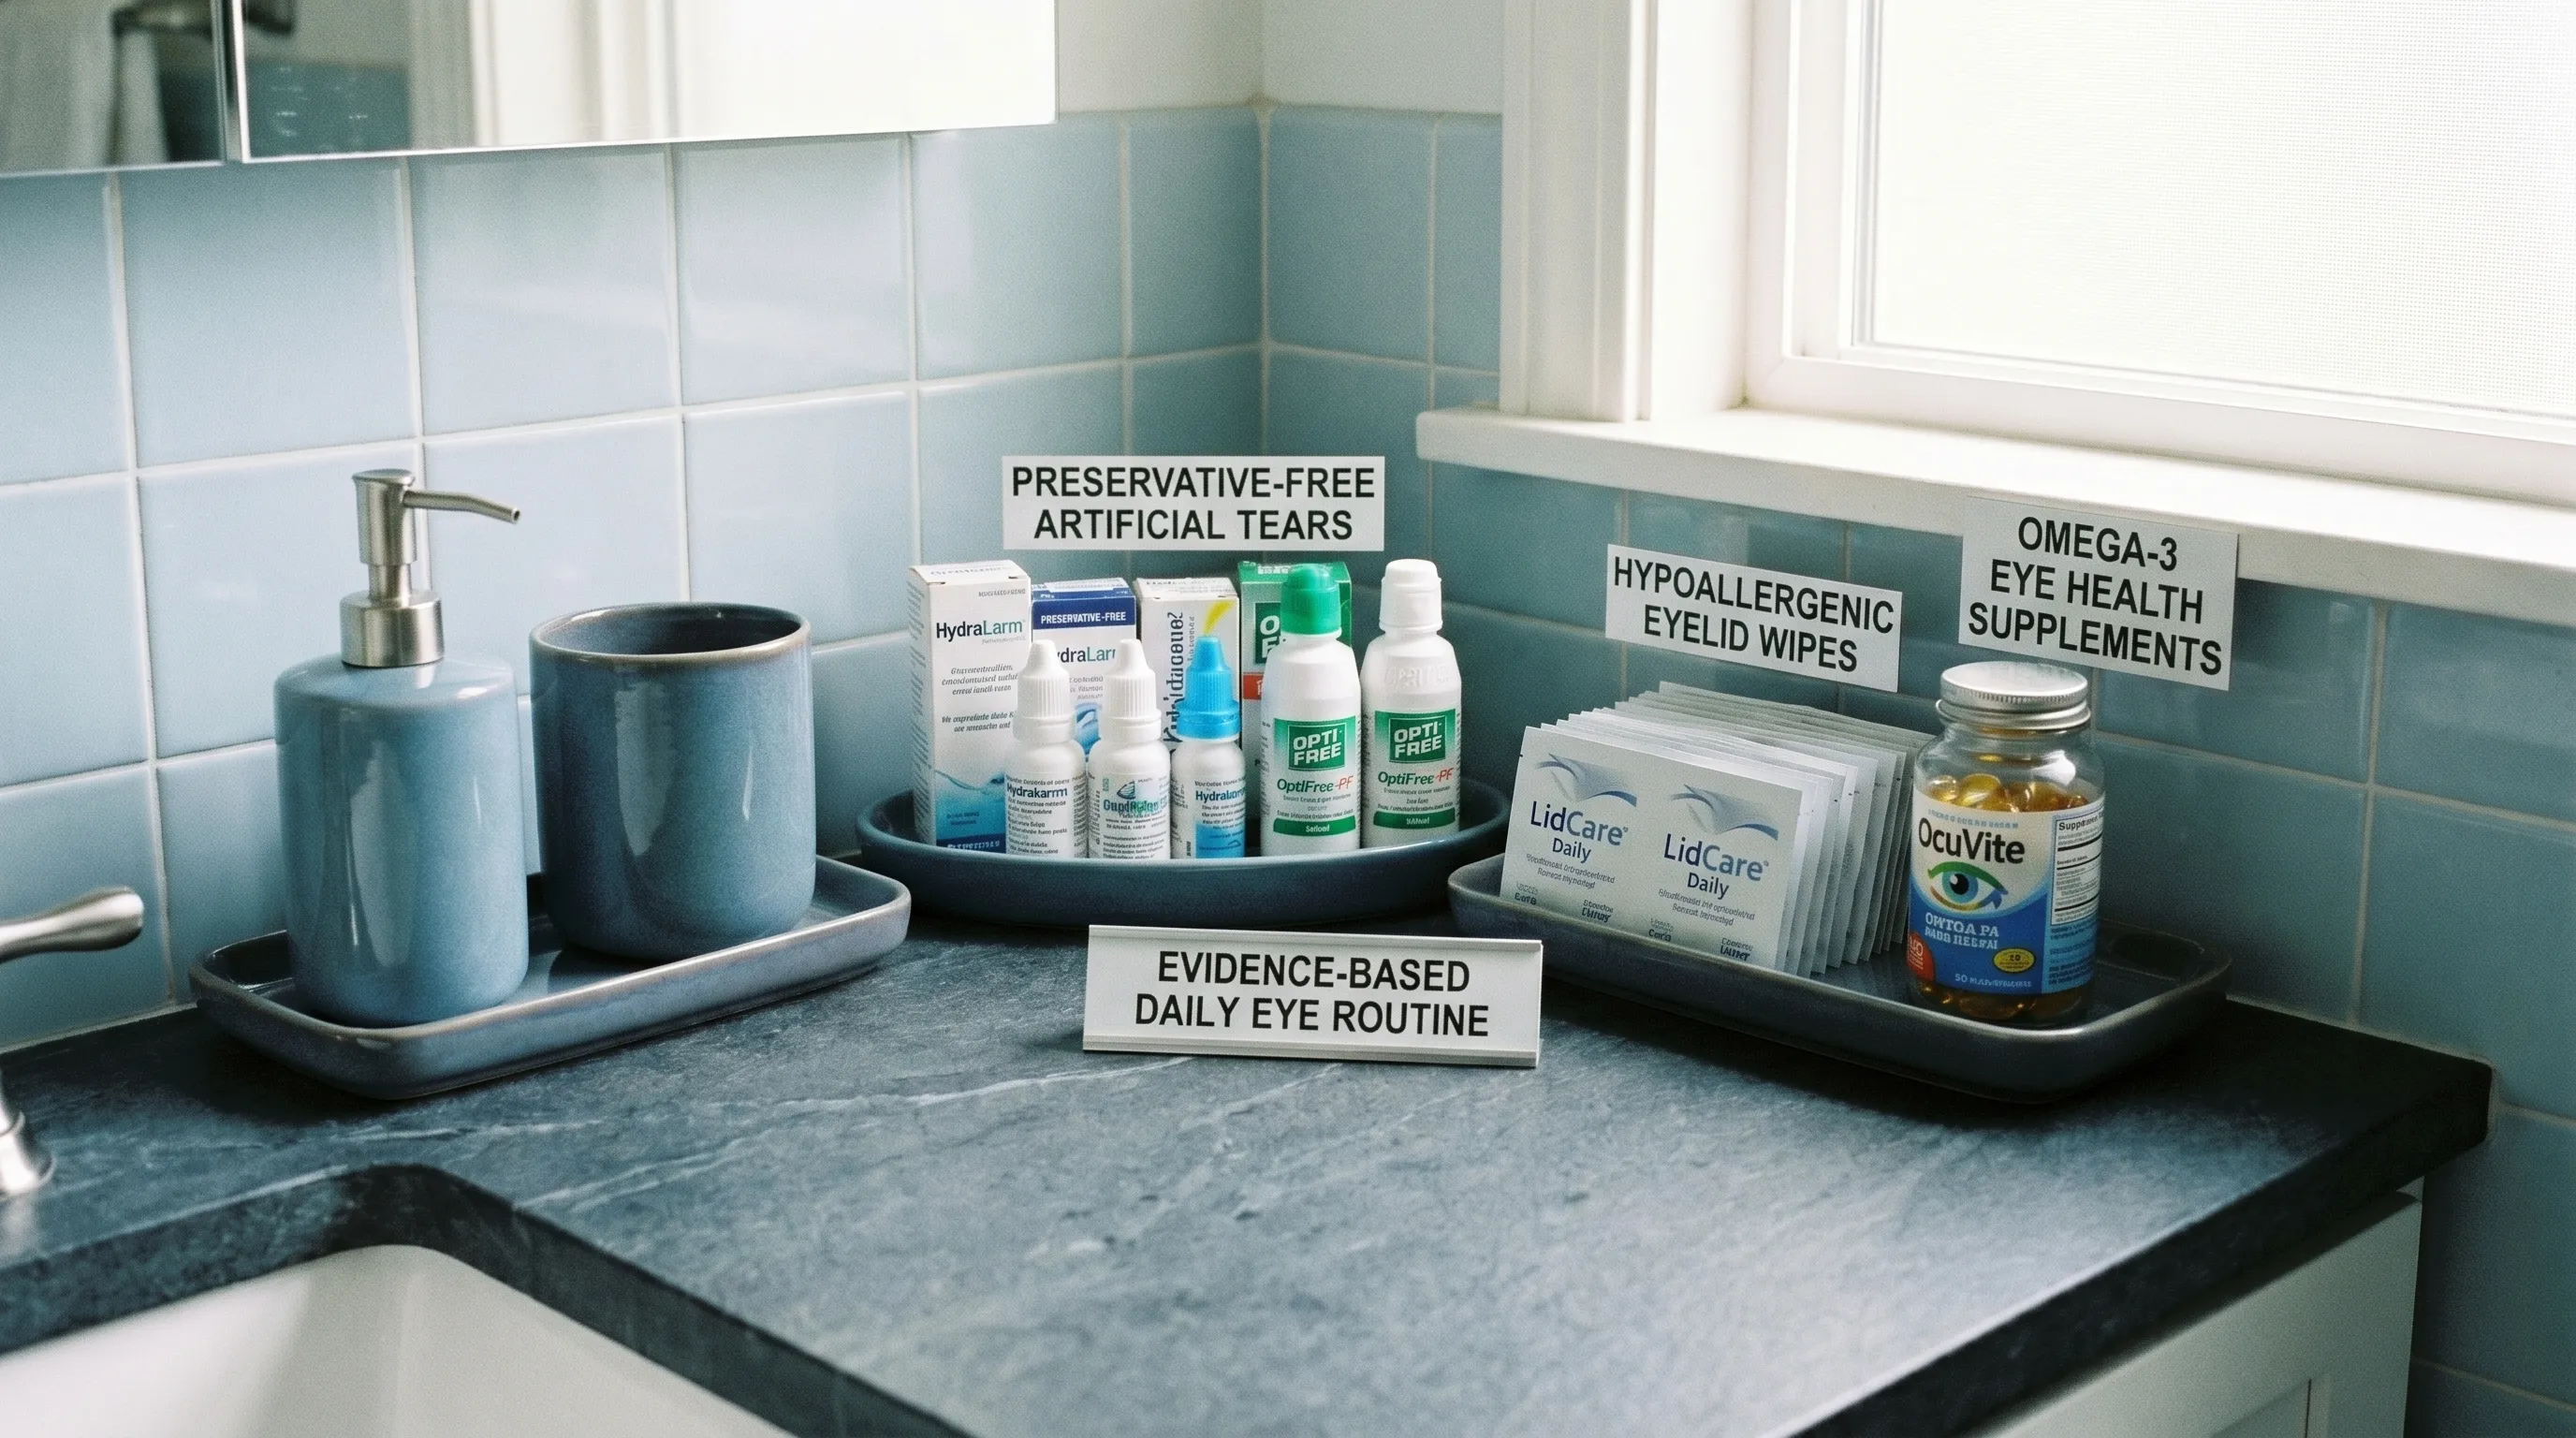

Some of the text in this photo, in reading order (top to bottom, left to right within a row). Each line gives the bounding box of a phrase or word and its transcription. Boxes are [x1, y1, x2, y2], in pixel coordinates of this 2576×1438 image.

[1012, 466, 1375, 498] PRESERVATIVE-FREE
[1033, 508, 1354, 540] ARTIFICIAL TEARS
[2017, 516, 2178, 572] OMEGA-3
[1614, 555, 1895, 634] HYPOALLERGENIC
[1990, 558, 2203, 624] EYE HEALTH
[936, 619, 1023, 643] HydraLarm
[1644, 604, 1858, 672] EYELID WIPES
[1968, 601, 2222, 676] SUPPLEMENTS
[1057, 647, 1117, 663] draLar
[1294, 741, 1342, 766] FREE
[1395, 734, 1442, 758] FREE
[1530, 800, 1623, 846] LidCare
[1918, 817, 2026, 865] OcuVite
[1552, 837, 1592, 864] Daily
[1663, 832, 1764, 882] LidCare
[1687, 872, 1730, 900] Daily
[1158, 950, 1471, 992] EVIDENCE-BASED
[1134, 993, 1489, 1037] DAILY EYE ROUTINE
